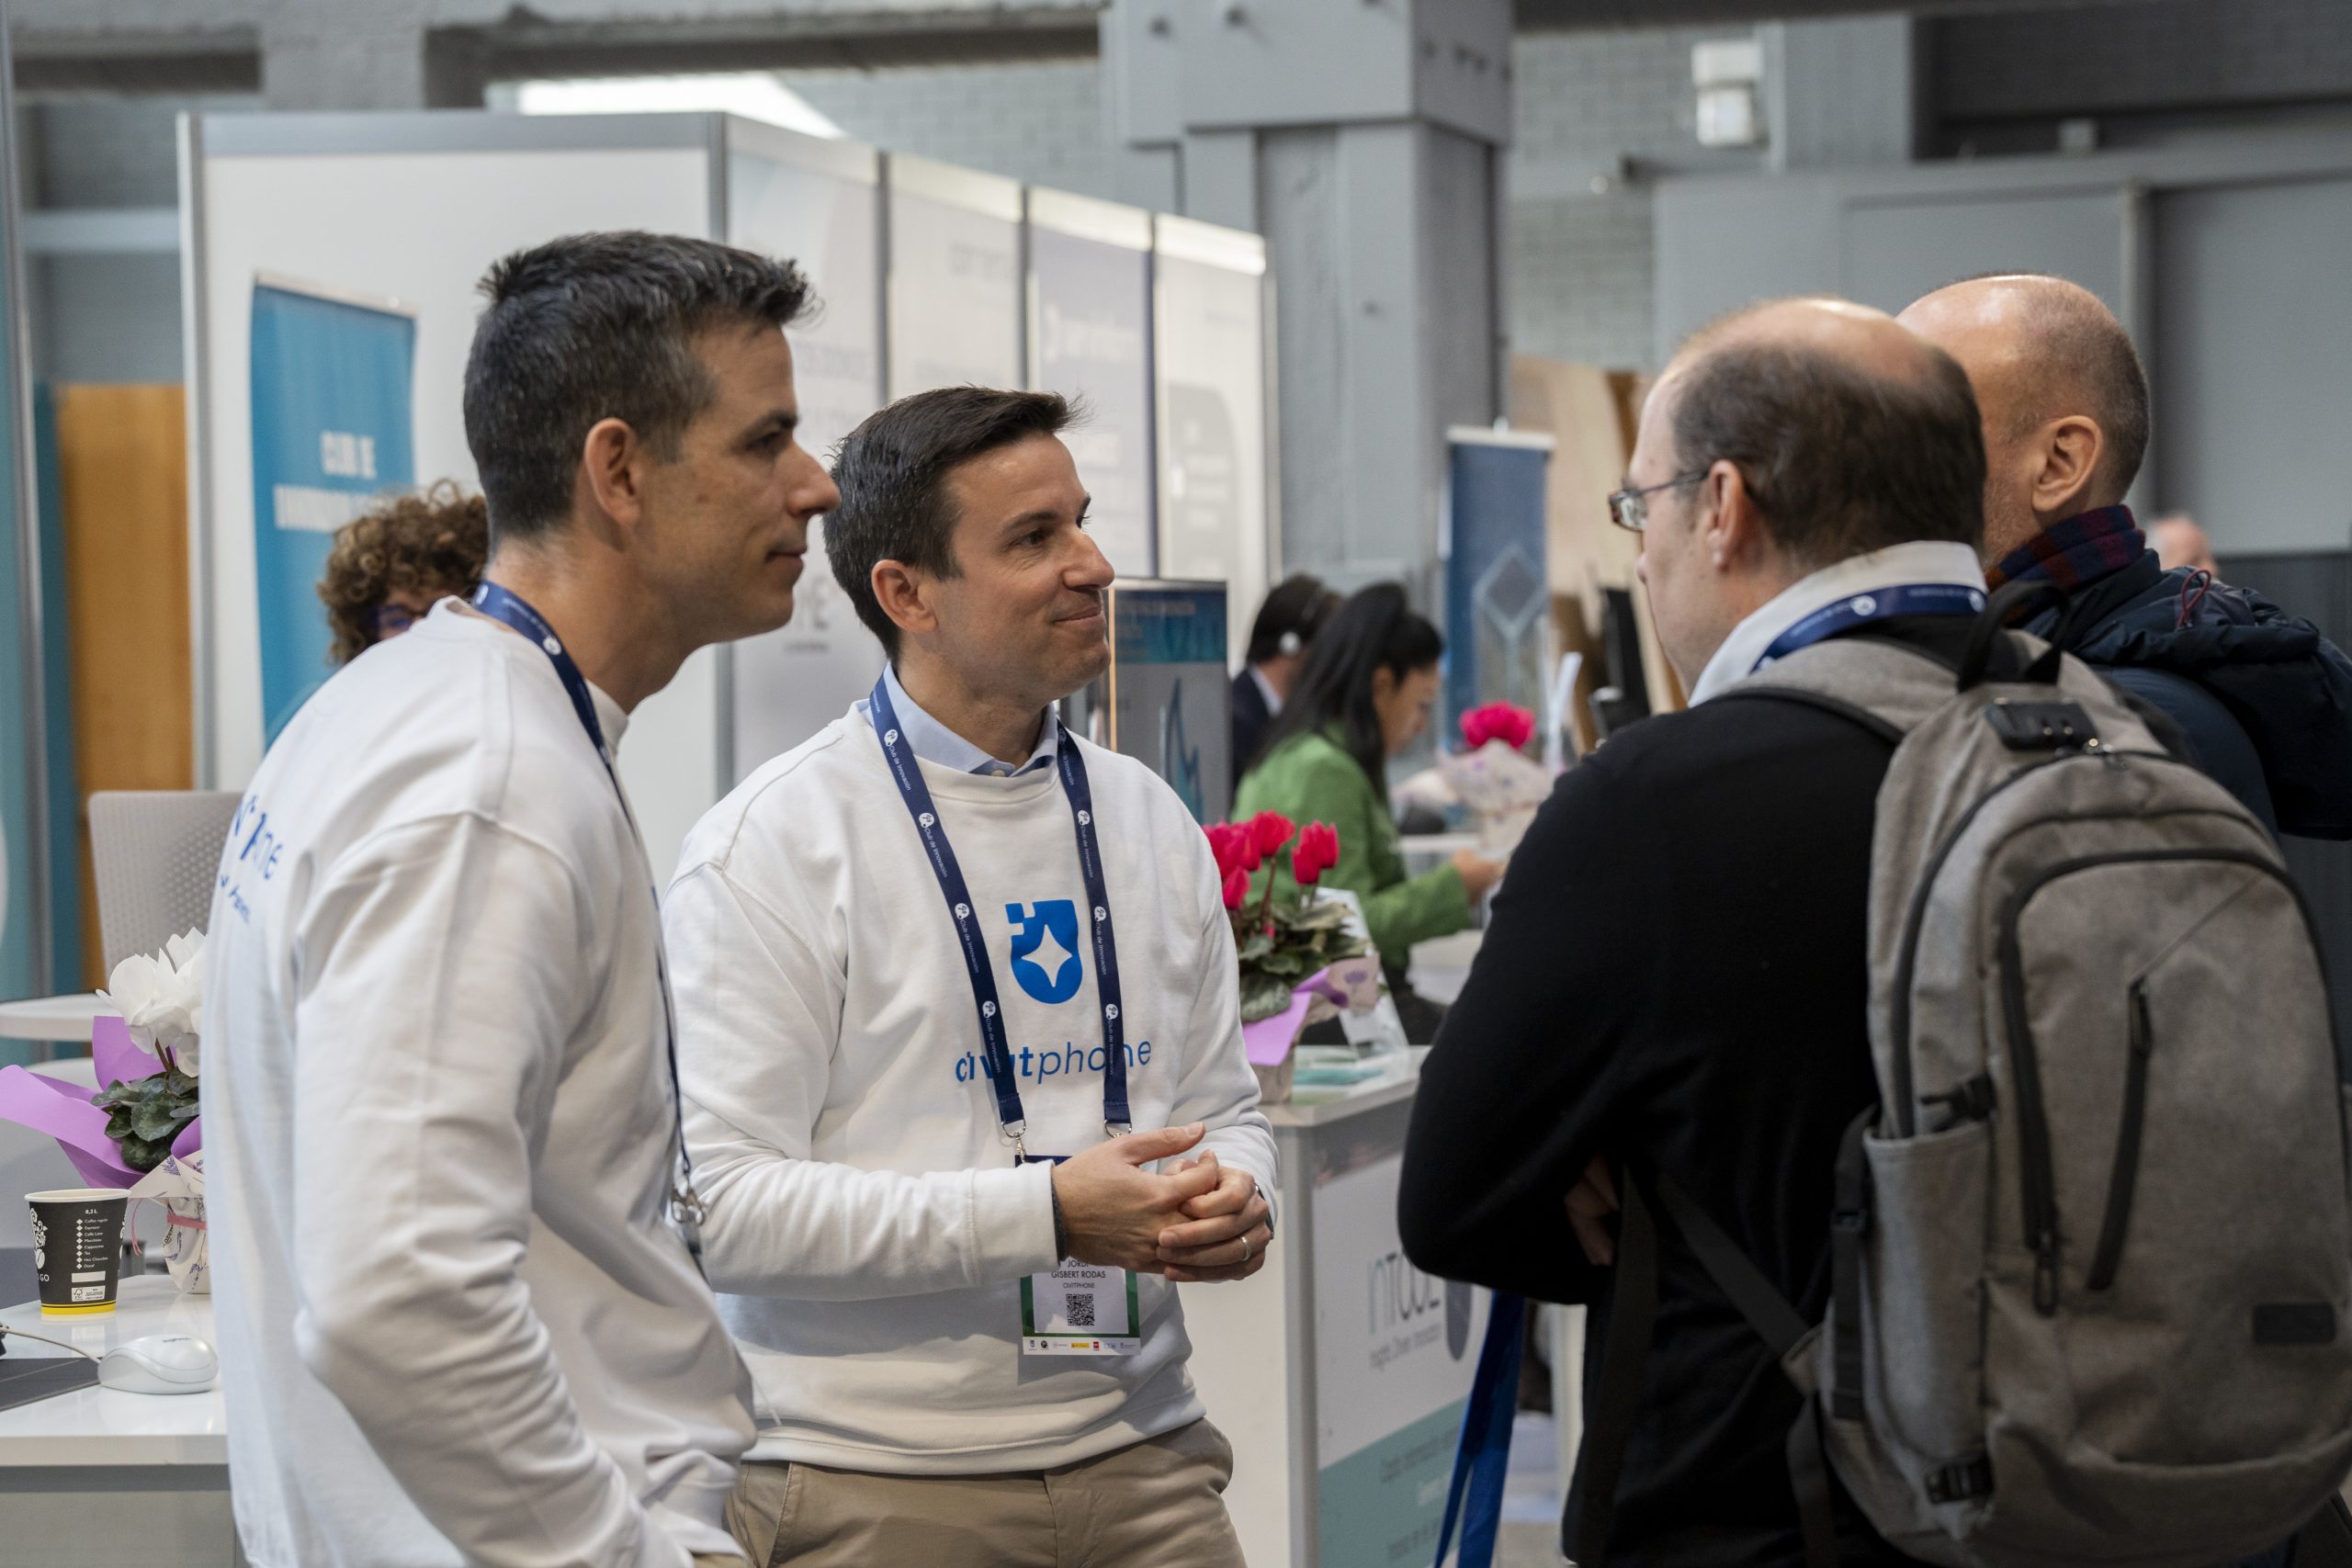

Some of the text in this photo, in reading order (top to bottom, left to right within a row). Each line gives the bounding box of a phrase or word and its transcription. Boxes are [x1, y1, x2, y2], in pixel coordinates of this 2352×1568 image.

[889, 745, 898, 758] Club
[897, 764, 911, 791] Innovación
[924, 828, 948, 878] Club de Innovación
[960, 920, 968, 934] Club
[40, 1274, 50, 1282] GO
[1051, 1270, 1106, 1279] GISBERT RODAS
